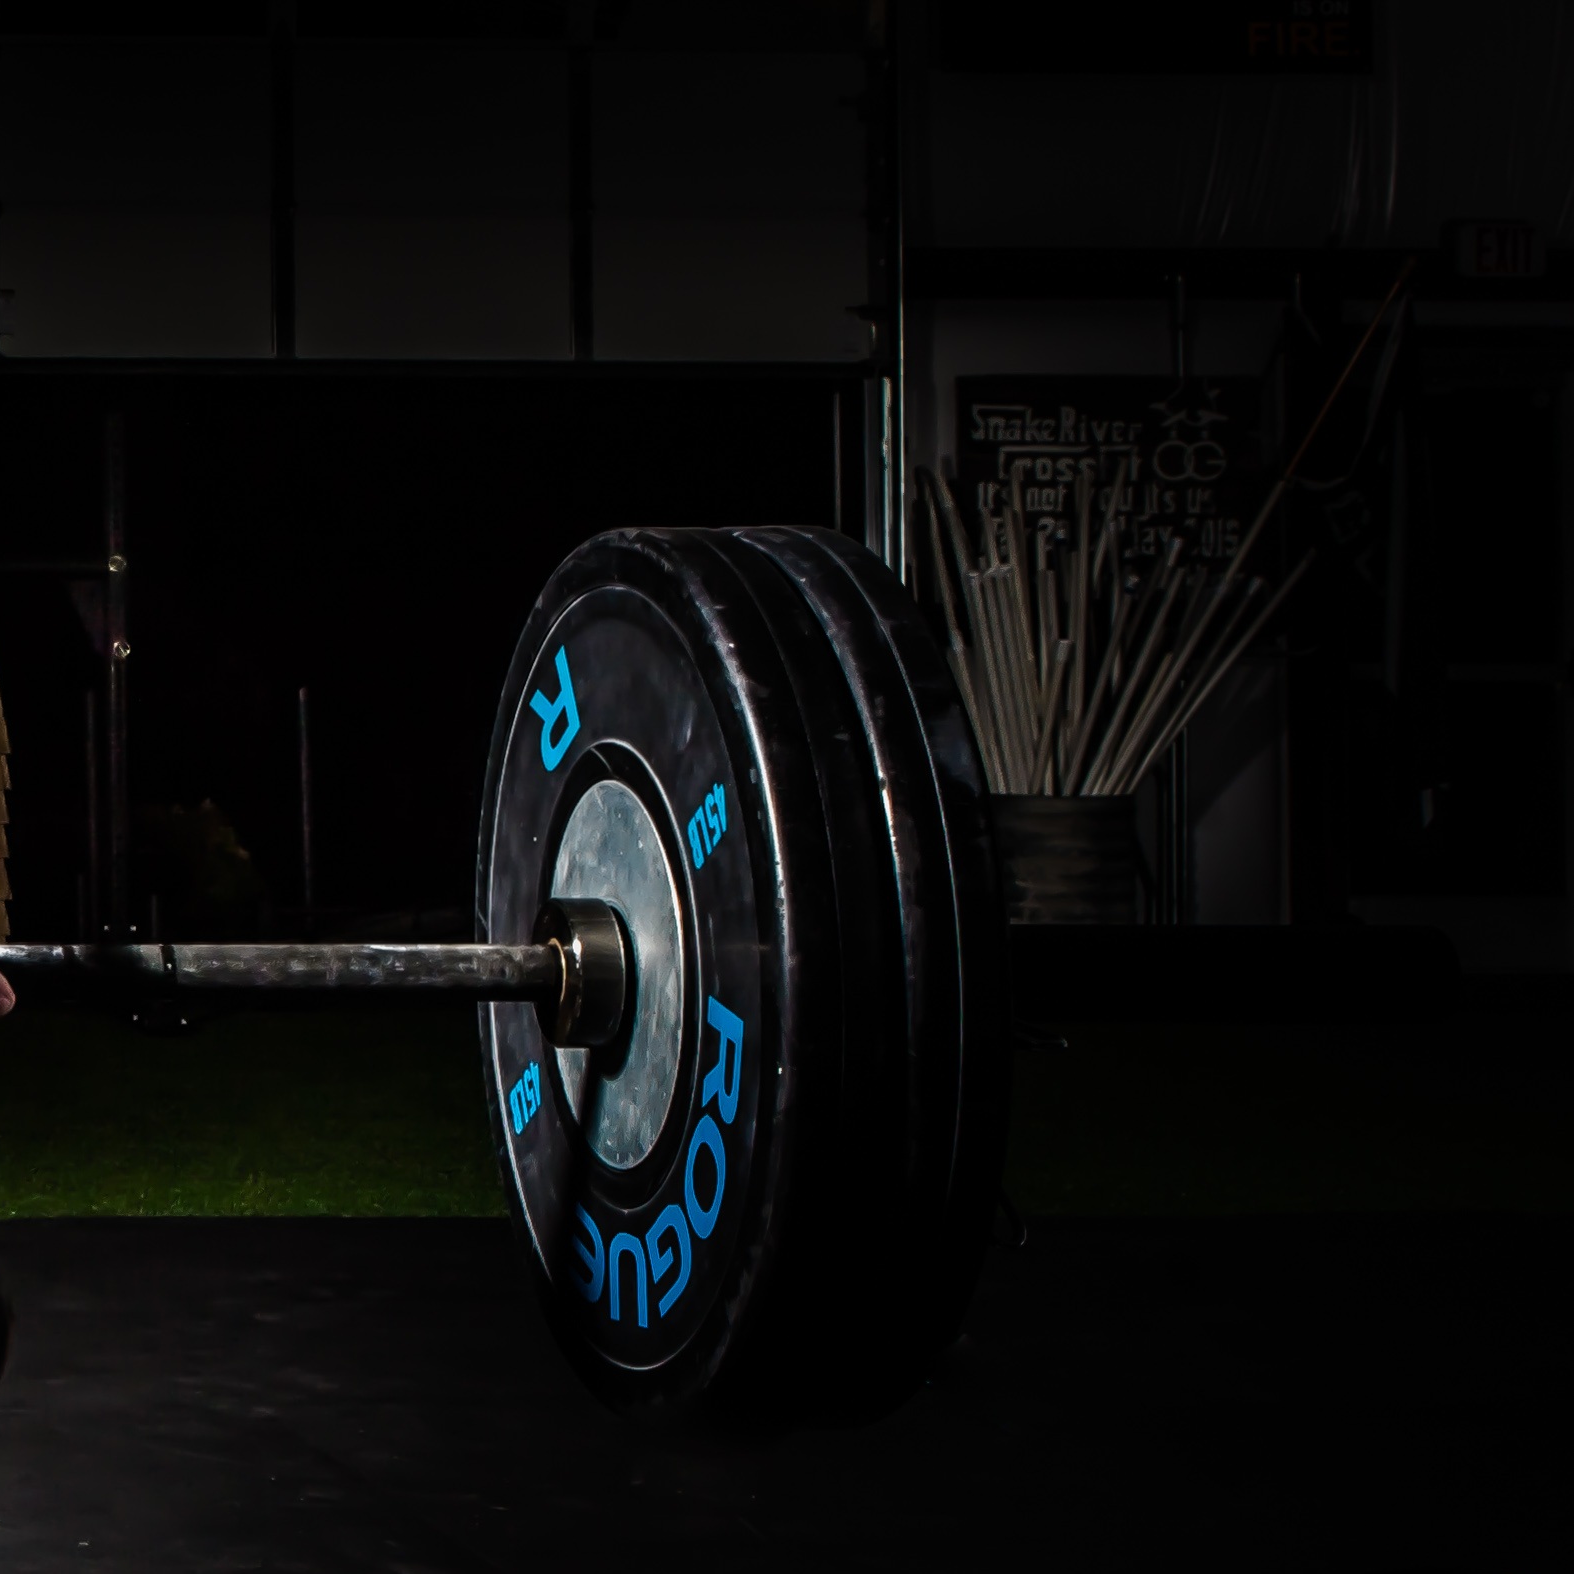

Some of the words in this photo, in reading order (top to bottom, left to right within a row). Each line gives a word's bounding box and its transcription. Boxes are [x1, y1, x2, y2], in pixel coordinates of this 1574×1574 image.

[1477, 227, 1535, 273] EXIT
[970, 404, 1056, 442] Snake
[1059, 406, 1144, 442] River
[528, 643, 583, 773] R
[687, 782, 728, 870] 45LB
[509, 1060, 542, 1136] 45LB
[571, 995, 745, 1330] ROGUE
